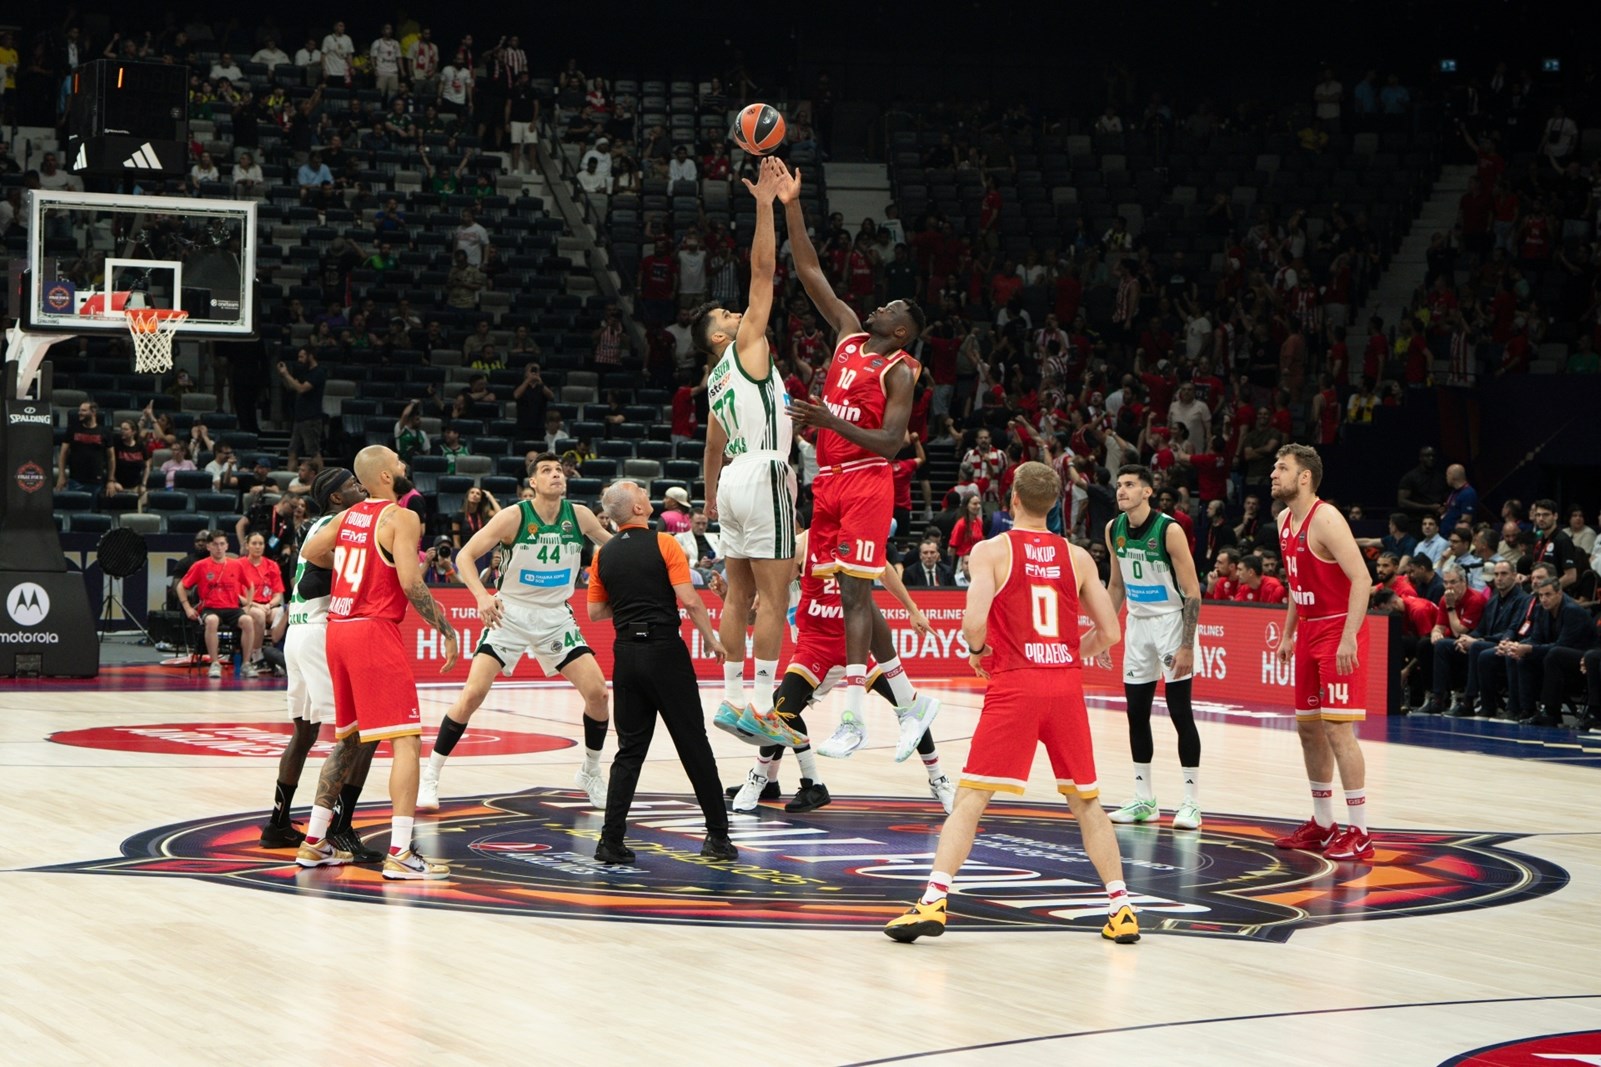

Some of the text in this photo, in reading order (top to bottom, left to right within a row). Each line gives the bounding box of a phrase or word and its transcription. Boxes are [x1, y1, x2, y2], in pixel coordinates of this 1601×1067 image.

[837, 366, 857, 390] 10
[9, 413, 51, 425] SPALDING
[712, 388, 739, 438] 77
[537, 545, 560, 564] 44
[856, 539, 875, 562] 10
[1024, 543, 1055, 562] WAKUP
[333, 545, 367, 592] 94
[1025, 563, 1061, 579] FMS
[1133, 560, 1143, 579] 0
[1285, 555, 1298, 578] 14
[1031, 583, 1059, 637] 0
[0, 631, 59, 644] motorola
[1197, 624, 1225, 637] RLINES
[1025, 642, 1073, 664] PIRAEUS
[1327, 683, 1349, 705] 14
